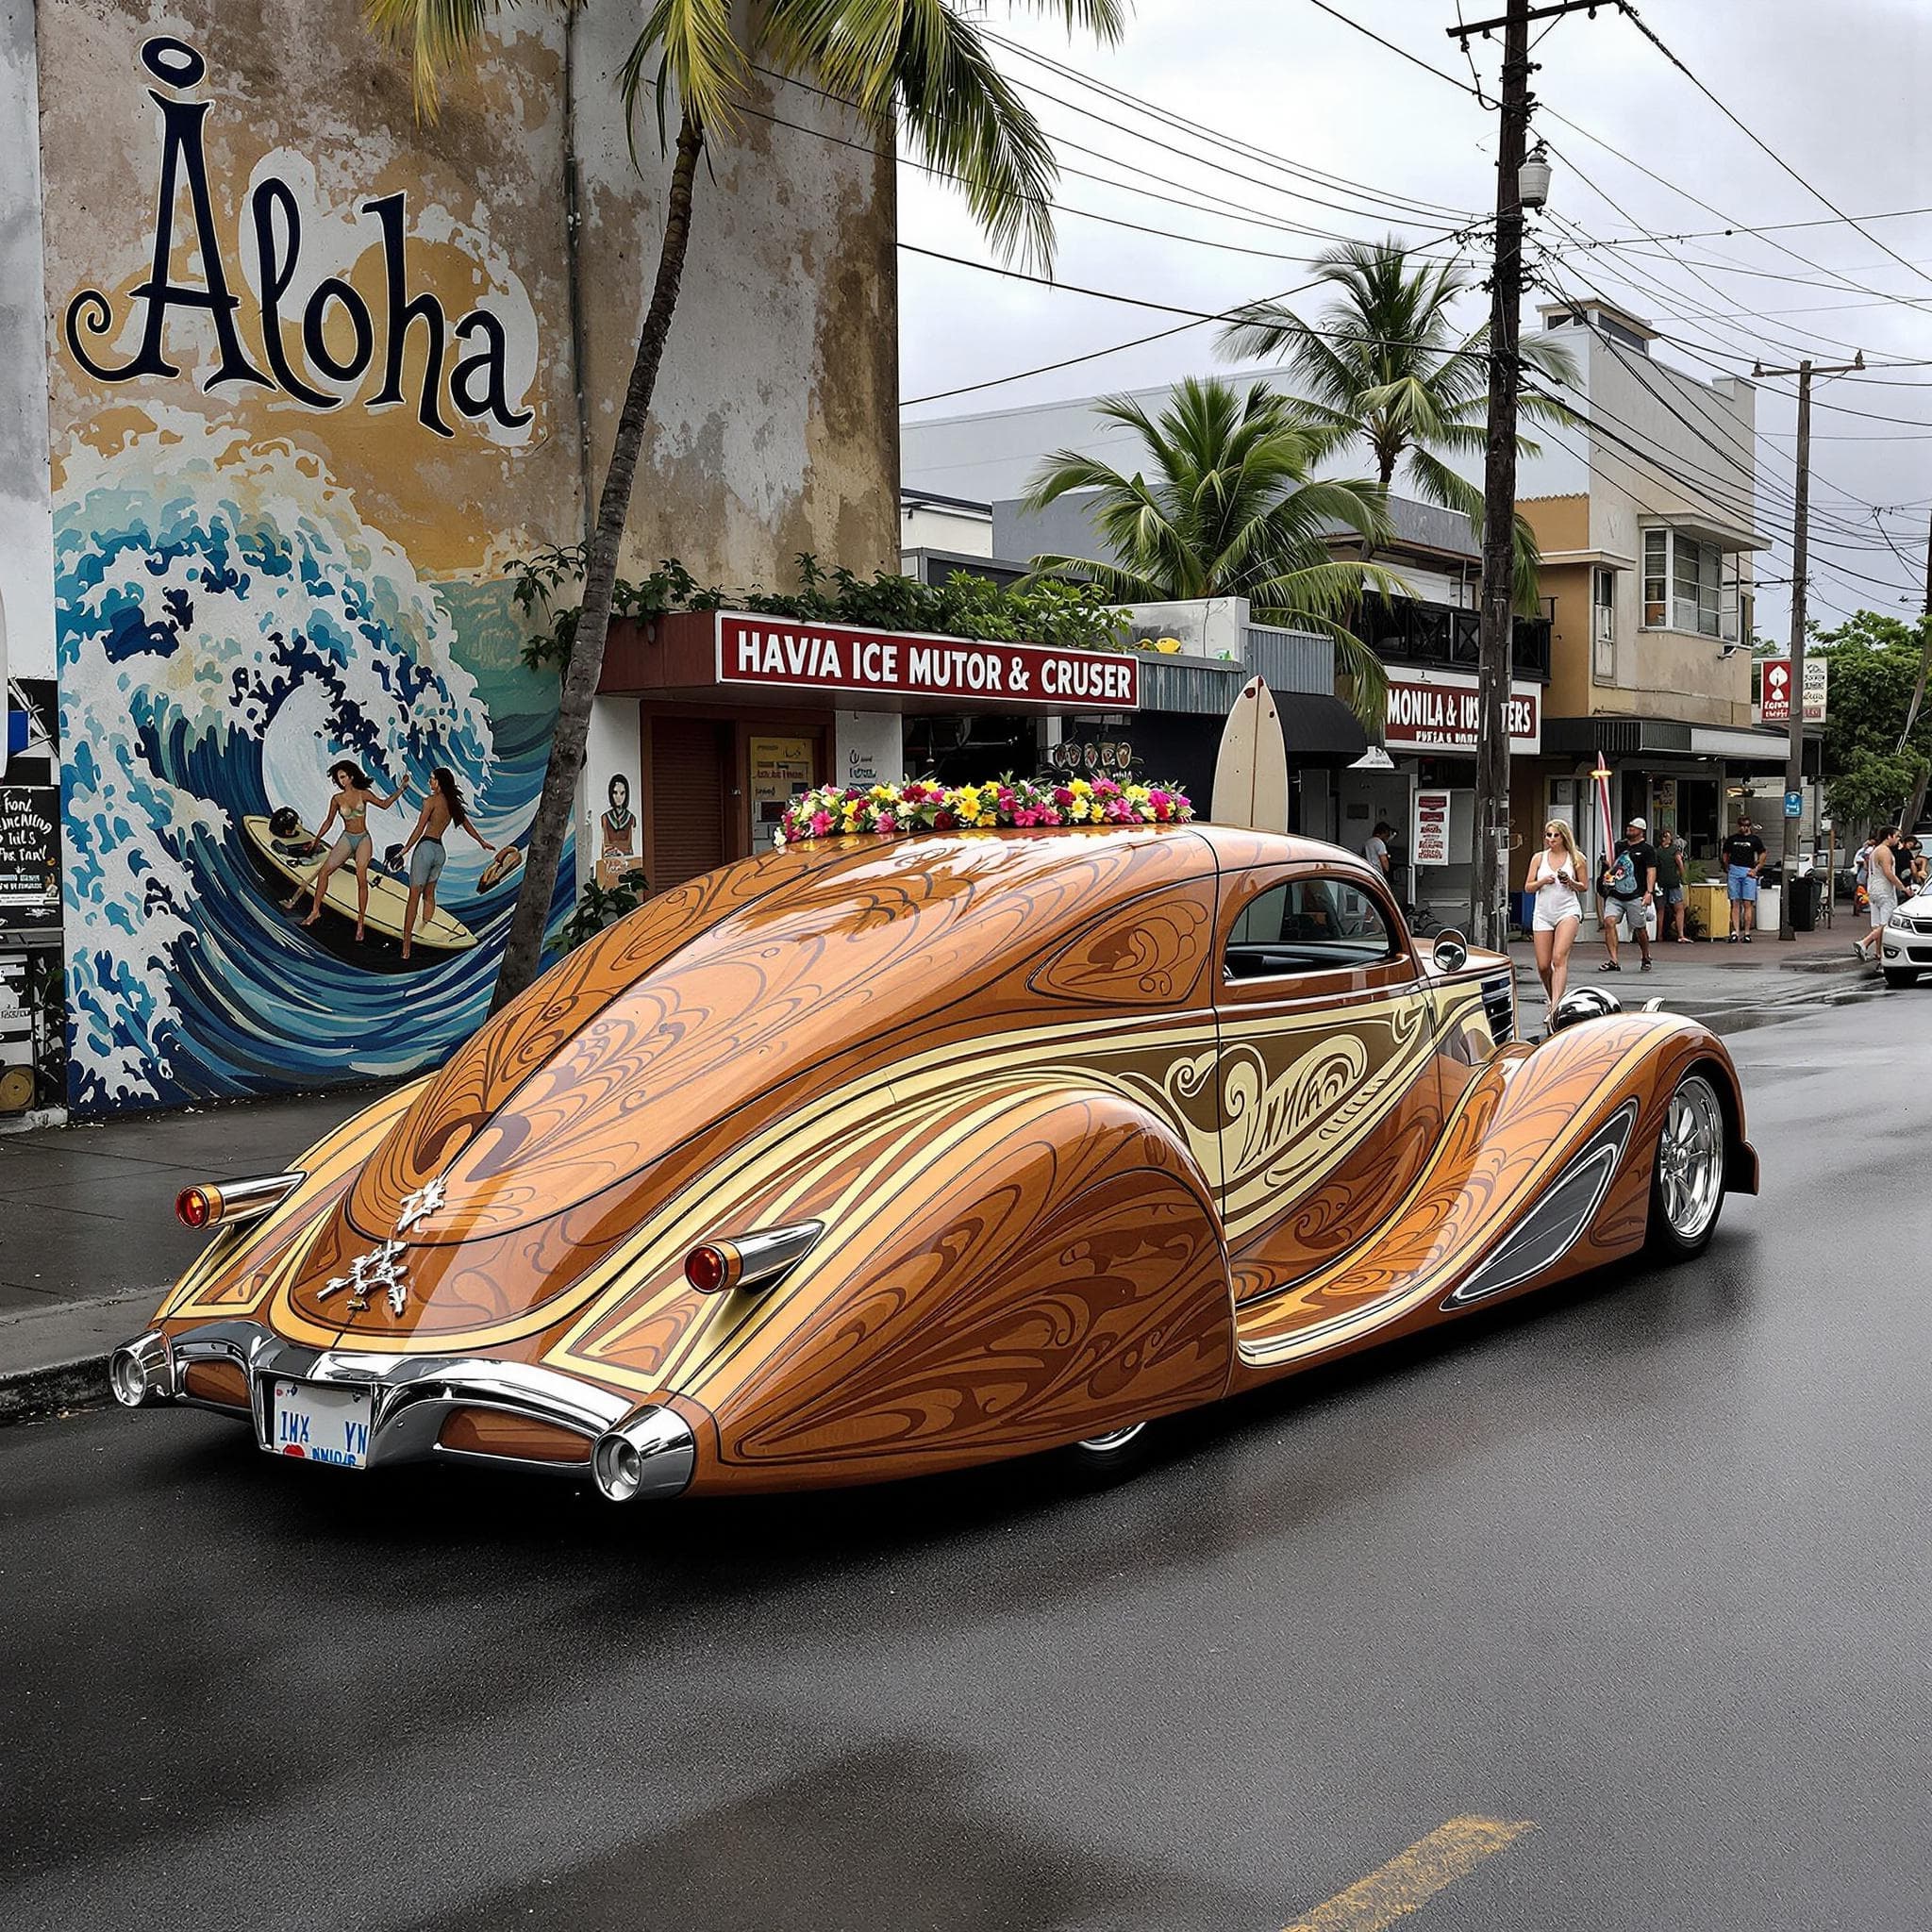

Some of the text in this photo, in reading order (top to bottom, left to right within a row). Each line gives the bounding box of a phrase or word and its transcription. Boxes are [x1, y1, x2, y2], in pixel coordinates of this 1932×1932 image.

[738, 630, 1132, 699] HAVIA ICE MUTOR & CRUSER
[1387, 688, 1444, 727] MONILA
[1445, 694, 1457, 727] &
